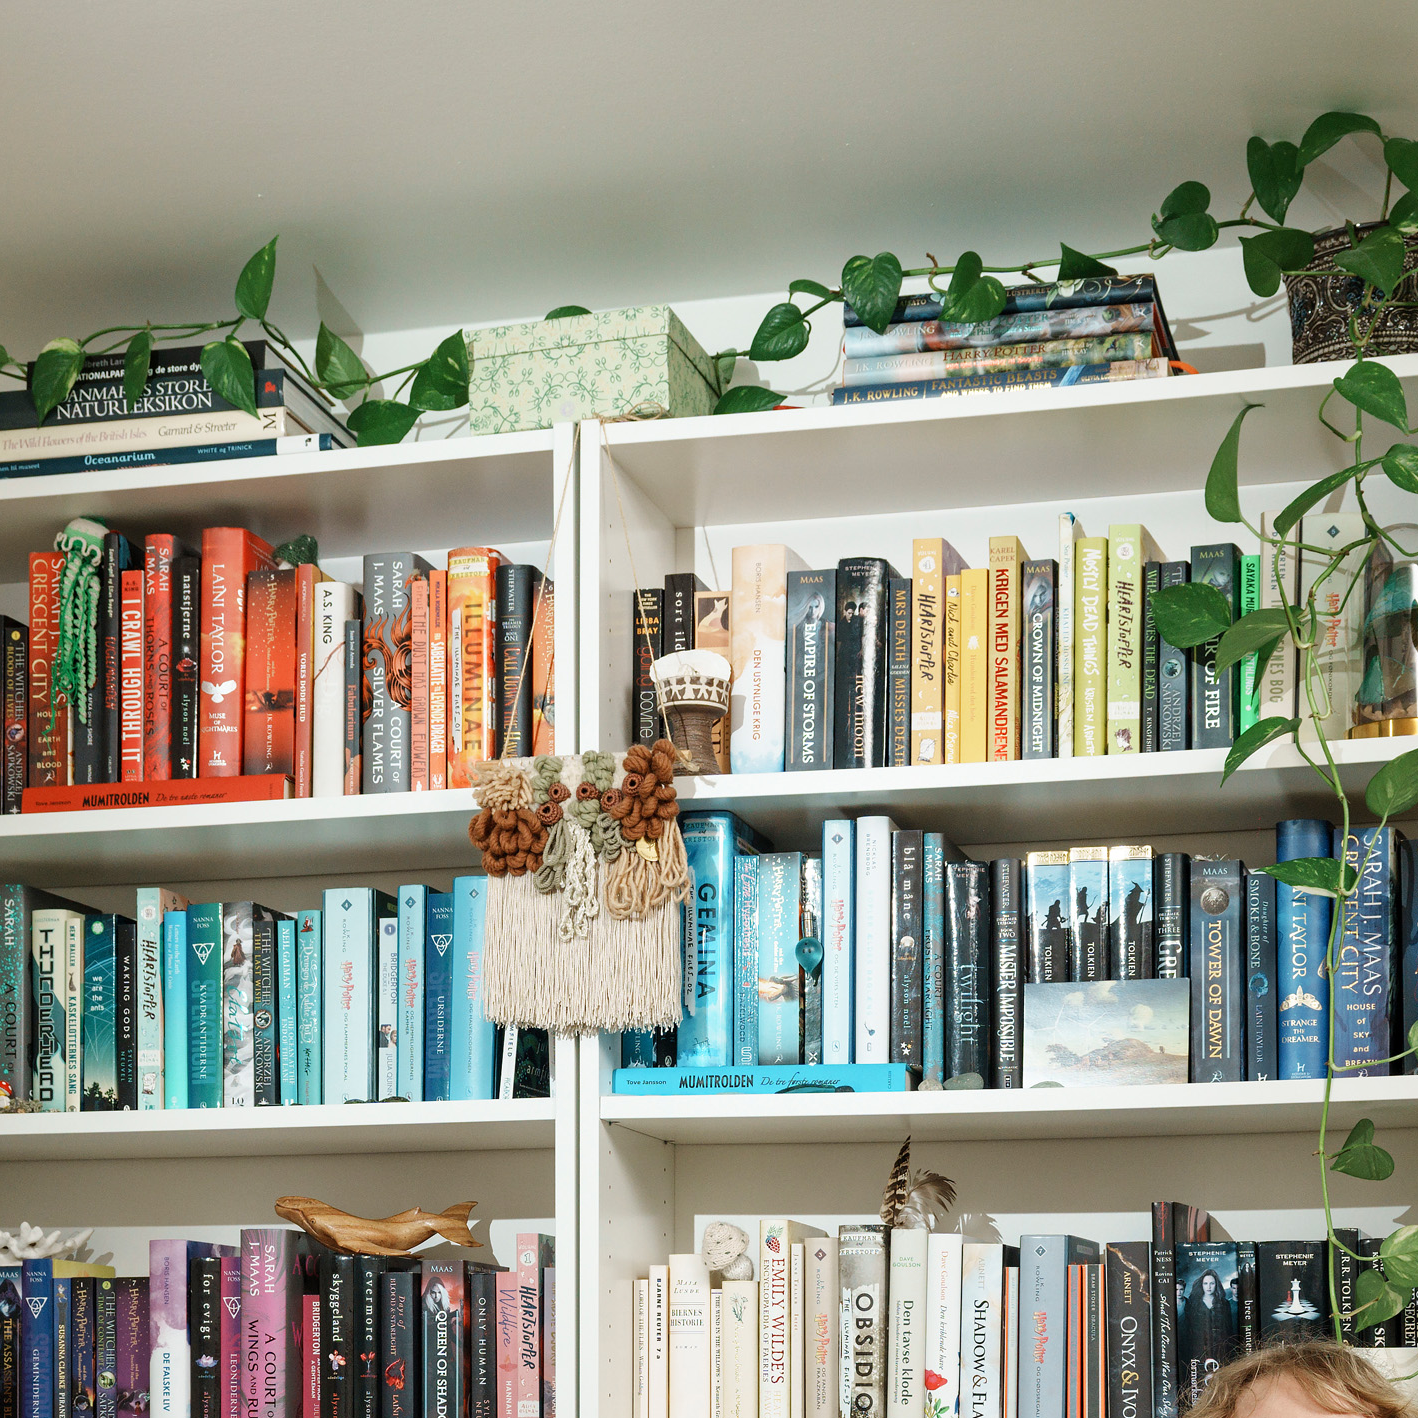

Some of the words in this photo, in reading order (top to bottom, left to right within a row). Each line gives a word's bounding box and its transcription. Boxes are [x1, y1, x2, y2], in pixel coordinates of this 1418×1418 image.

[932, 376, 1005, 390] FANTASTIC
[1007, 369, 1058, 383] BEASTS
[84, 450, 156, 465] Oceanarium
[227, 444, 253, 452] TRINICK
[32, 559, 48, 653] CRESCENT
[181, 575, 193, 639] natstjerne
[212, 564, 226, 608] LAINI
[322, 590, 332, 612] A.S.
[995, 569, 1009, 618] KRIGEN
[122, 610, 141, 661] CRAWL
[322, 615, 332, 644] KING
[1082, 596, 1101, 632] DEAD
[211, 613, 225, 675] TAYLOR
[804, 623, 816, 677] EMPIRE
[919, 593, 936, 681] HEARTSTOPPER
[995, 623, 1009, 652] MED
[1032, 613, 1043, 663] CROWN
[1083, 635, 1100, 675] THINGS
[32, 659, 48, 703] CITY
[464, 603, 482, 751] ILLUMINAE
[753, 650, 762, 669] DEN
[1032, 665, 1042, 683] OF
[373, 667, 384, 717] SILVER
[752, 671, 762, 716] USYNLIGE
[803, 680, 816, 700] OF
[994, 658, 1007, 761] SALAMANDRENE
[347, 685, 357, 740] Fabularium
[752, 719, 761, 740] KRIG
[802, 703, 815, 763] STORMS
[1032, 685, 1042, 752] MIDNIGHT
[122, 748, 141, 762] IT
[373, 724, 384, 784] FLAMES
[82, 792, 150, 808] MUMITROLDEN
[903, 847, 914, 870] blå
[1362, 835, 1382, 906] SARAH
[903, 880, 915, 919] måne
[1249, 879, 1260, 923] SMOKE
[697, 882, 717, 999] GEMINA
[1208, 920, 1222, 980] TOWER
[1250, 924, 1259, 933] &
[997, 944, 1018, 992] MISTER
[1044, 945, 1053, 980] TOLKIEN
[1087, 942, 1095, 977] TOLKIEN
[1128, 941, 1136, 976] TOLKIEN
[1250, 935, 1260, 969] BONE
[1363, 932, 1382, 996] MAAS
[123, 955, 131, 1001] WAKING
[142, 939, 158, 1020] HEARTSTOPPER
[1208, 984, 1222, 1005] OF
[68, 996, 77, 1070] KASKELOTTERNES
[199, 985, 207, 1080] KVADRANTIDERNE
[436, 995, 445, 1055] URSIDERNE
[996, 993, 1018, 1062] IMPOSSIBLE
[1208, 1009, 1222, 1059] DAWN
[68, 1073, 77, 1094] SANG
[678, 1074, 754, 1089] MUMITROLDEN
[249, 1242, 259, 1252] J.
[264, 1245, 275, 1293] SARAH
[203, 1274, 213, 1295] for
[249, 1255, 260, 1297] MAAS
[771, 1258, 786, 1310] EMILY
[200, 1303, 212, 1340] evigt
[331, 1273, 343, 1342] skyggeland
[365, 1271, 374, 1341] evermore
[903, 1300, 914, 1326] Den
[58, 1324, 66, 1360] SUSANNA
[248, 1320, 259, 1372] WINGS
[436, 1310, 447, 1356] QUEEN
[771, 1314, 785, 1384] WILDE'S
[855, 1293, 874, 1412] OBSIDIO
[902, 1331, 912, 1364] tavse
[972, 1299, 990, 1374] SHADOW
[1120, 1316, 1138, 1368] ONYX
[58, 1361, 66, 1389] CLARKE
[163, 1353, 170, 1365] DE
[436, 1359, 447, 1376] OF
[1122, 1370, 1139, 1388] &
[901, 1368, 913, 1405] klode
[972, 1374, 988, 1389] &
